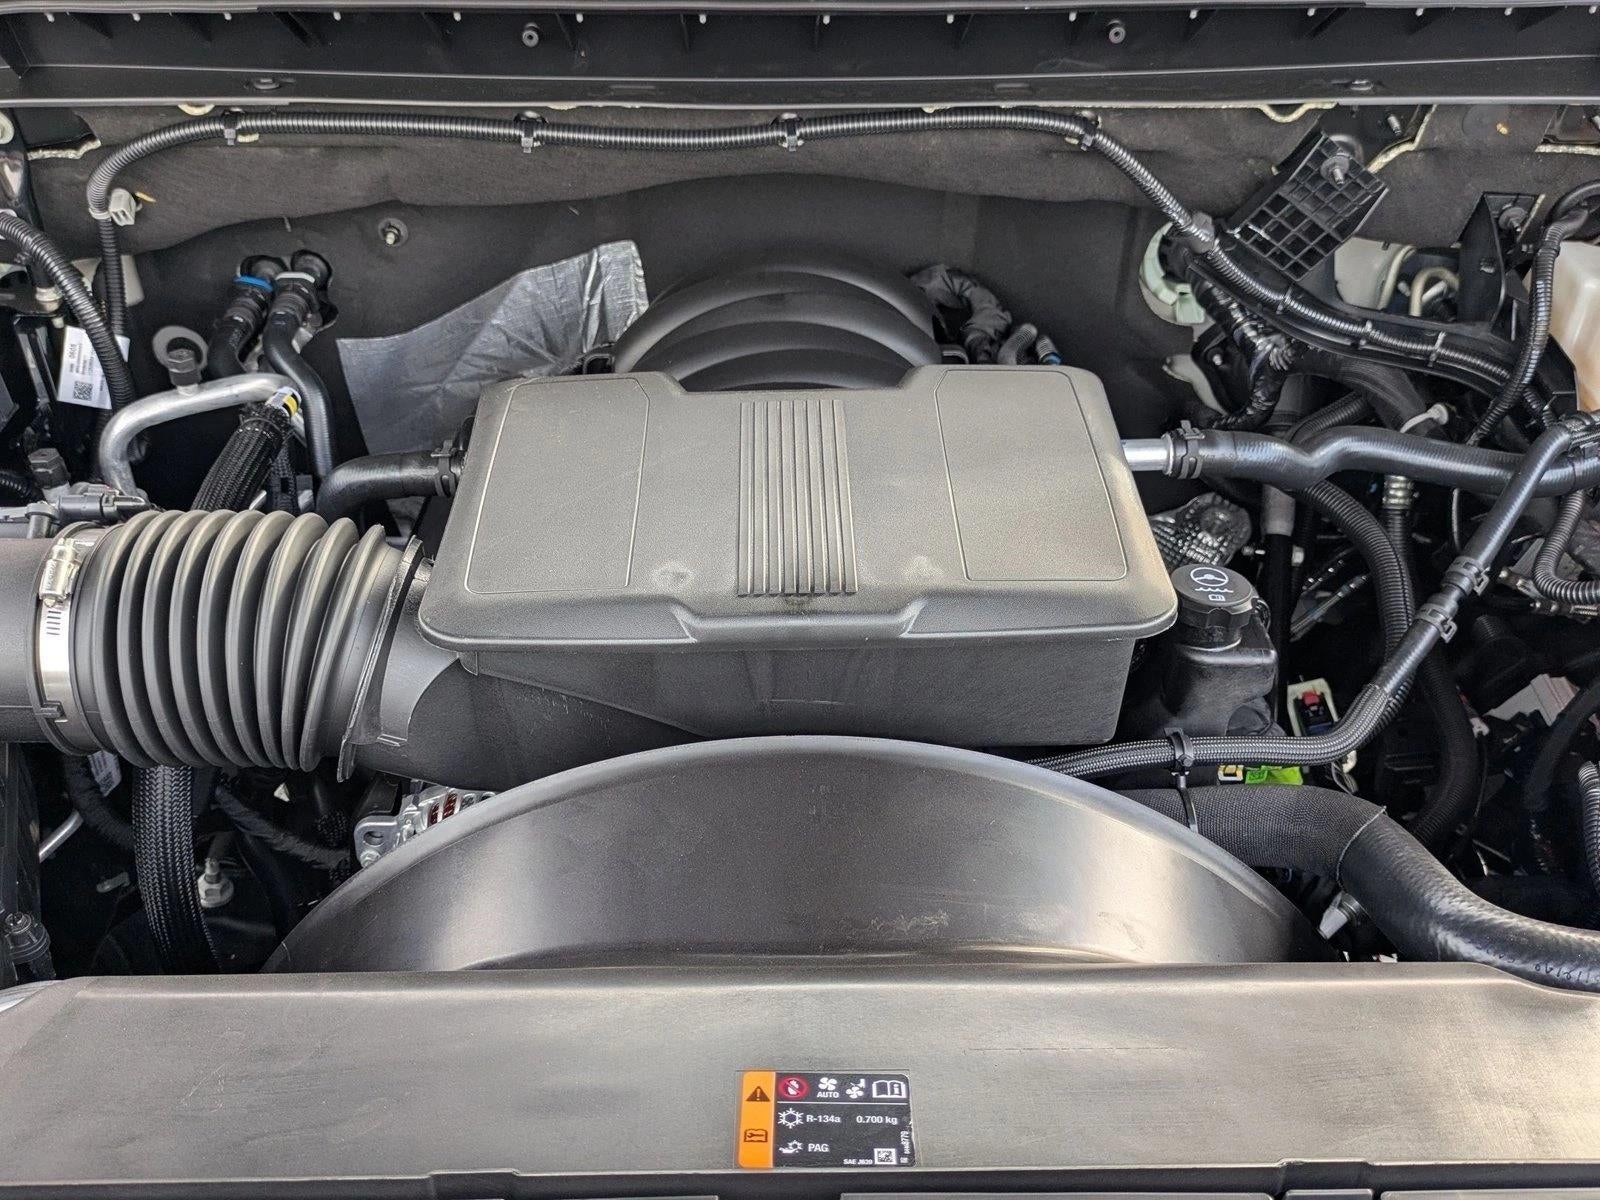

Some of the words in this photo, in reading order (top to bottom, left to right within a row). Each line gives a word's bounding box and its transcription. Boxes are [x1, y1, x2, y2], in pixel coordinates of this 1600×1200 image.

[816, 1091, 840, 1099] AUTO
[806, 1114, 841, 1124] R-134a
[856, 1114, 883, 1124] 0.700
[885, 1115, 898, 1125] kg
[807, 1143, 830, 1153] PAG
